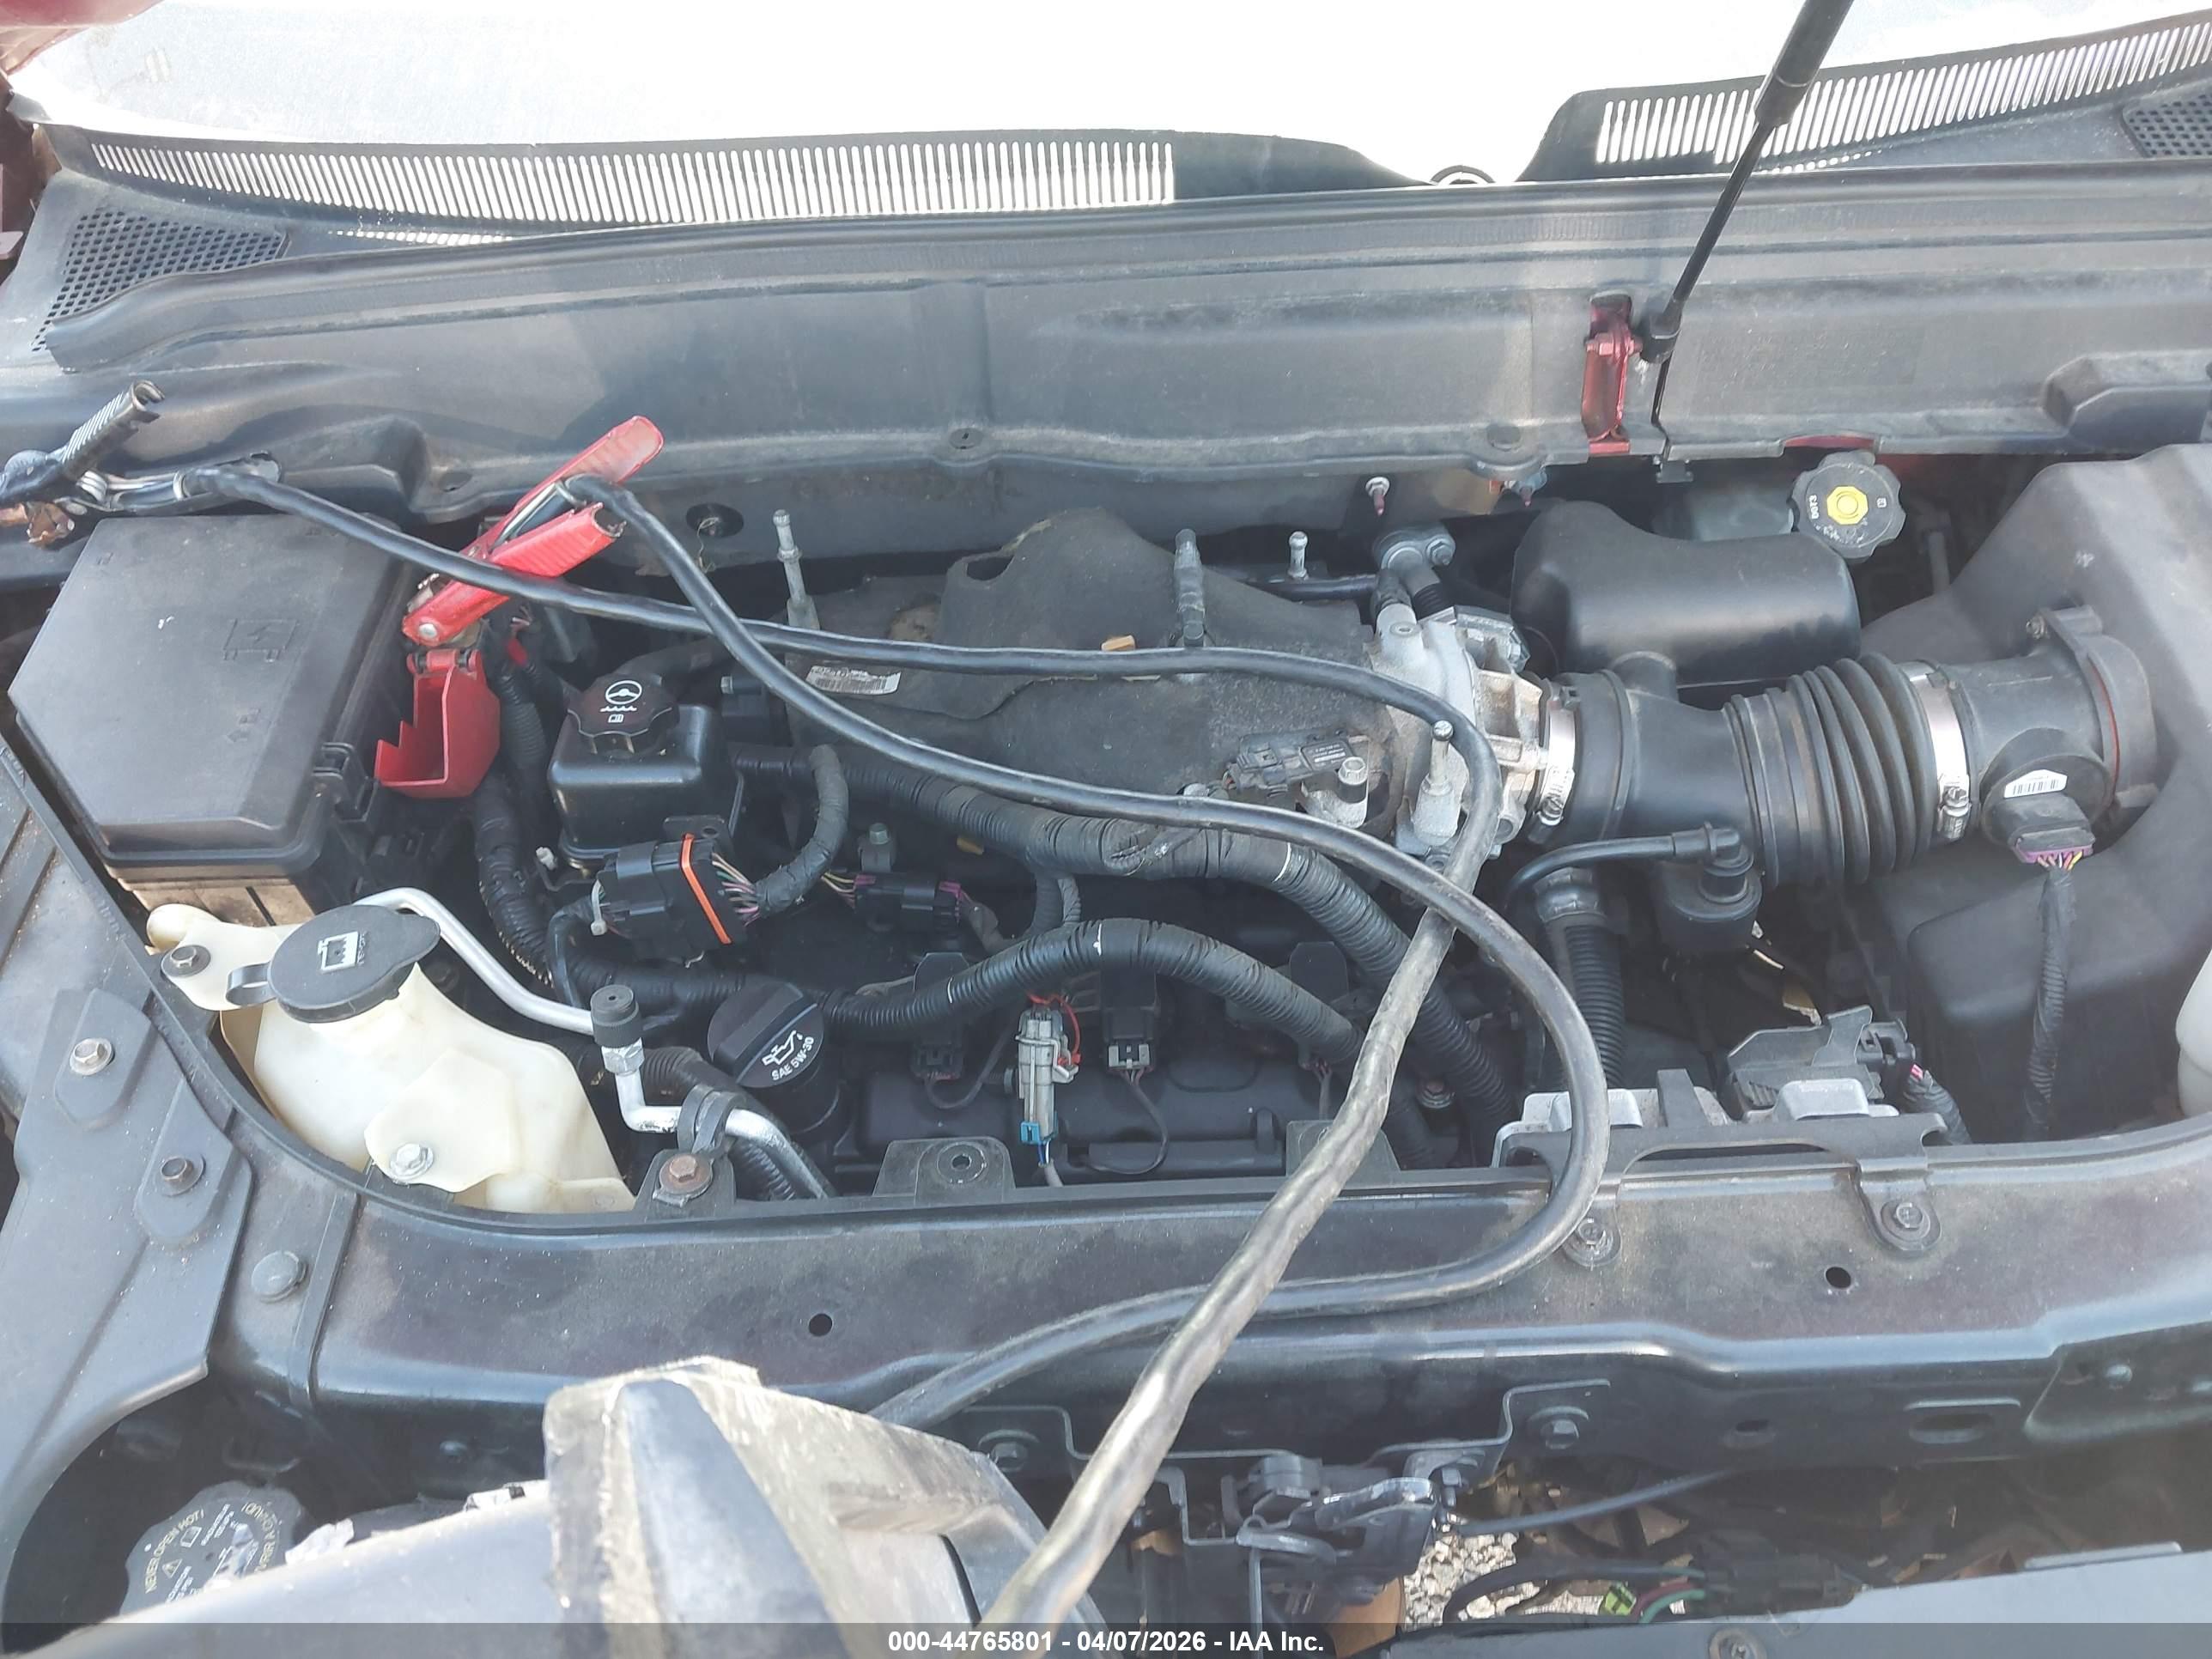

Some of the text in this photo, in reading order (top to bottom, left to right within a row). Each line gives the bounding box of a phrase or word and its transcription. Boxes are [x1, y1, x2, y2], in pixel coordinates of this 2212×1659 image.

[772, 1036, 815, 1081] SAE 5W-30
[153, 1527, 179, 1558] OPEN
